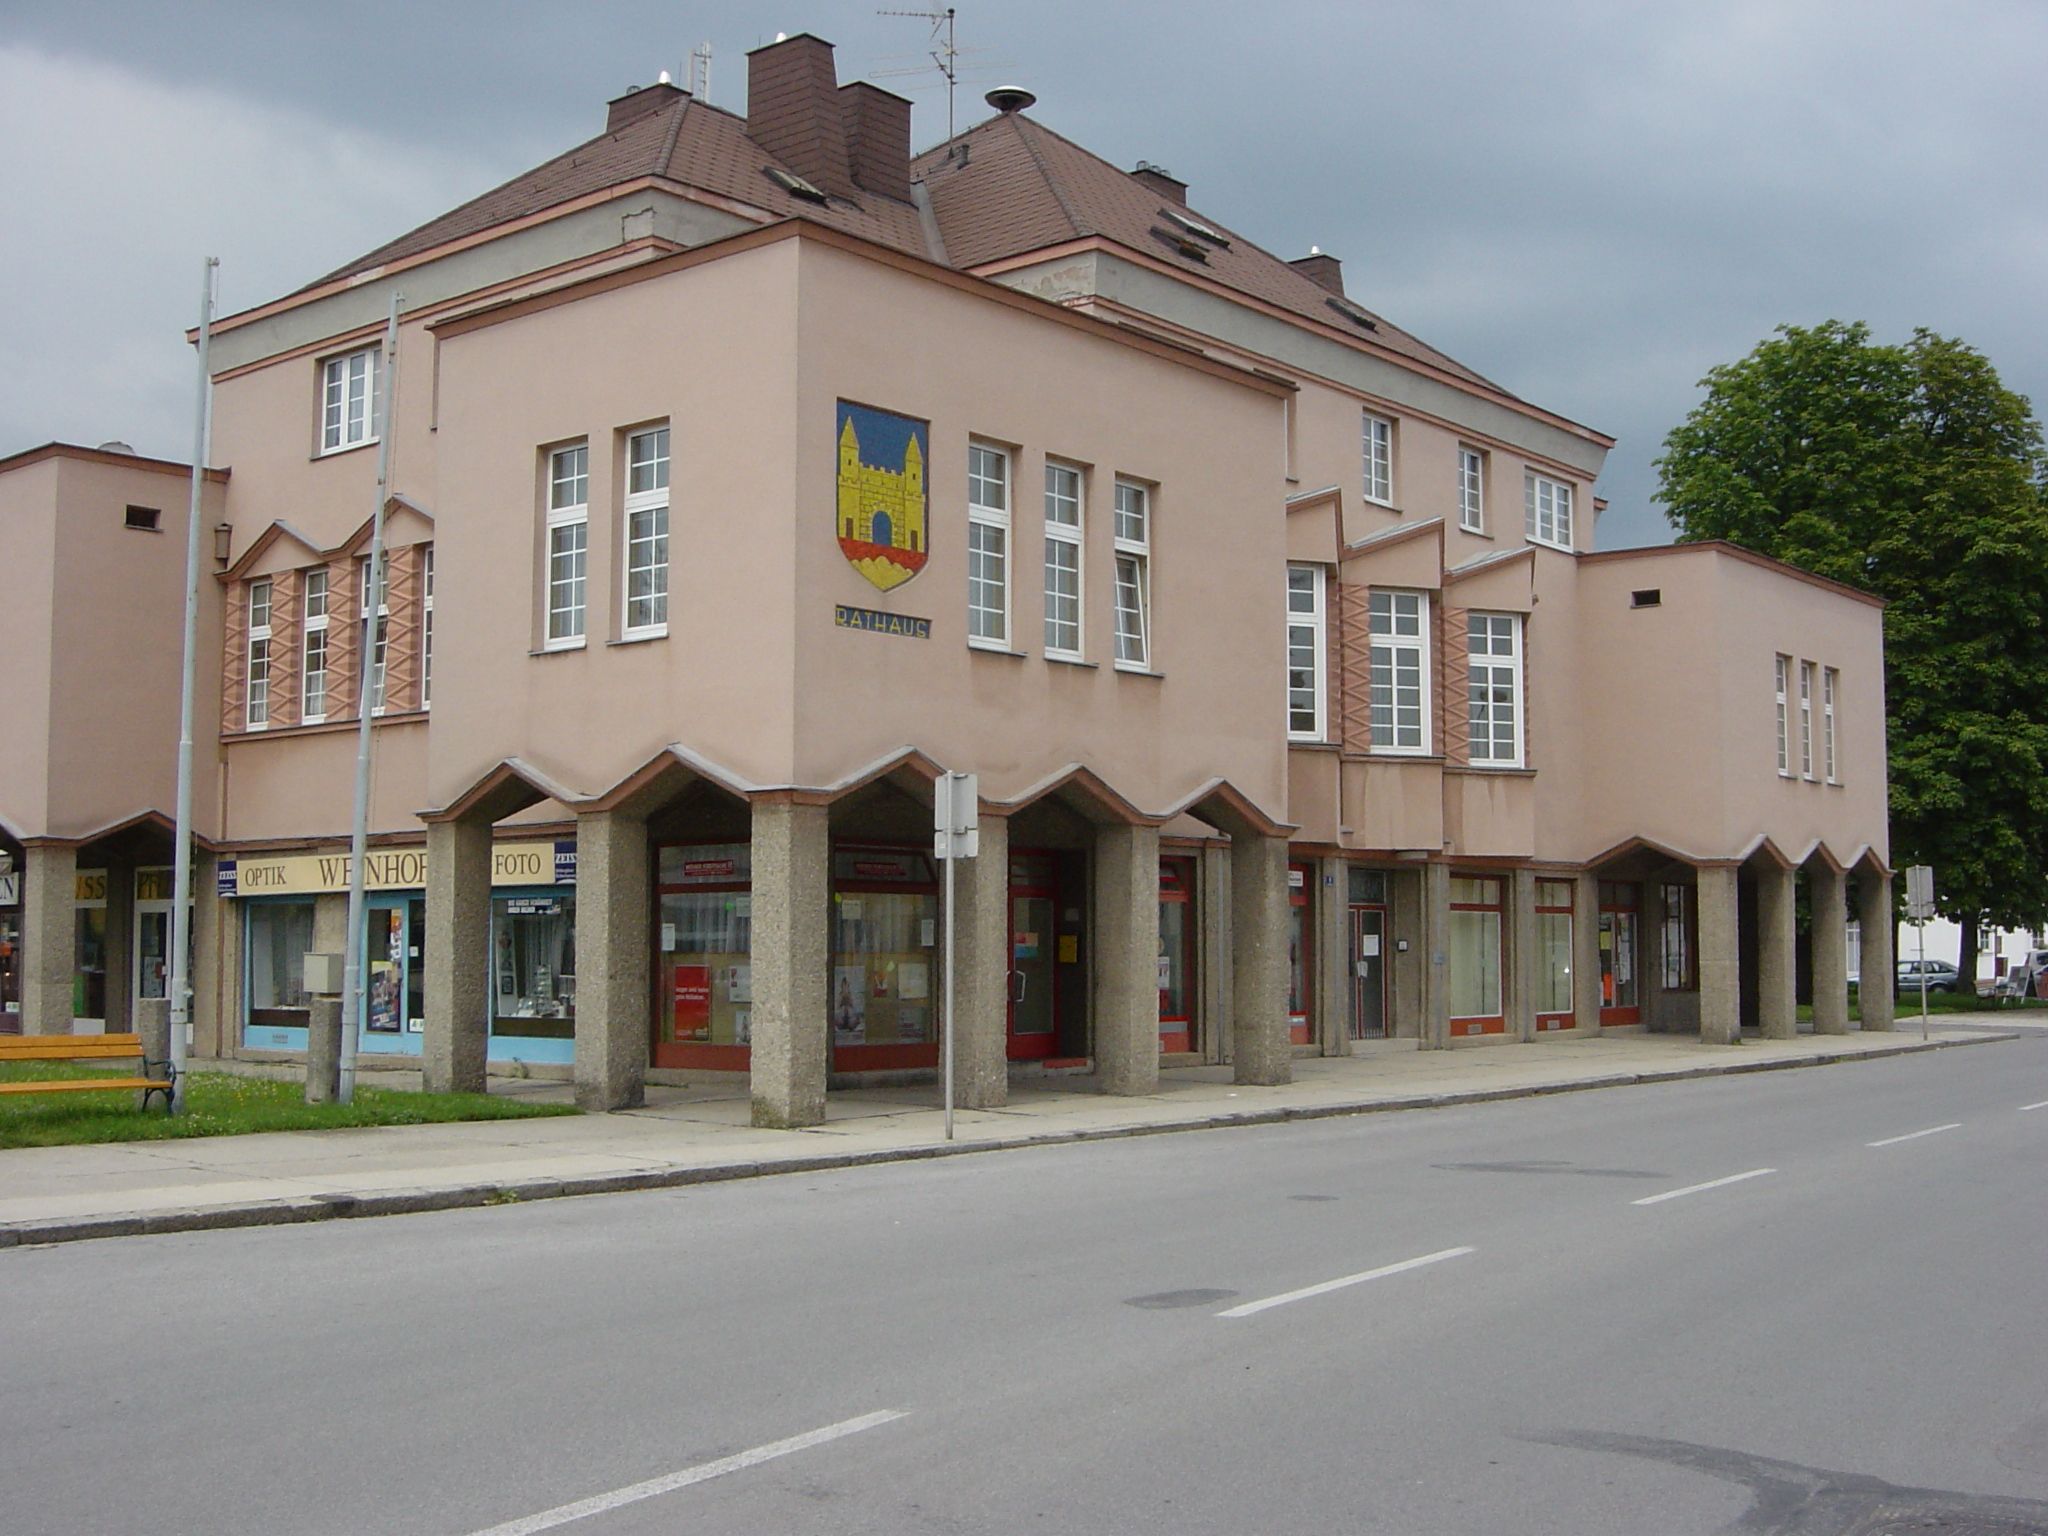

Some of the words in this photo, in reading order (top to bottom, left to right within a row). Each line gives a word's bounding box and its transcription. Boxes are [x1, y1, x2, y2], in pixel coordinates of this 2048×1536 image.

[835, 607, 927, 637] RATHAUS
[245, 865, 287, 887] OPTIK
[495, 853, 541, 875] FOTO
[555, 853, 577, 864] ZEIS
